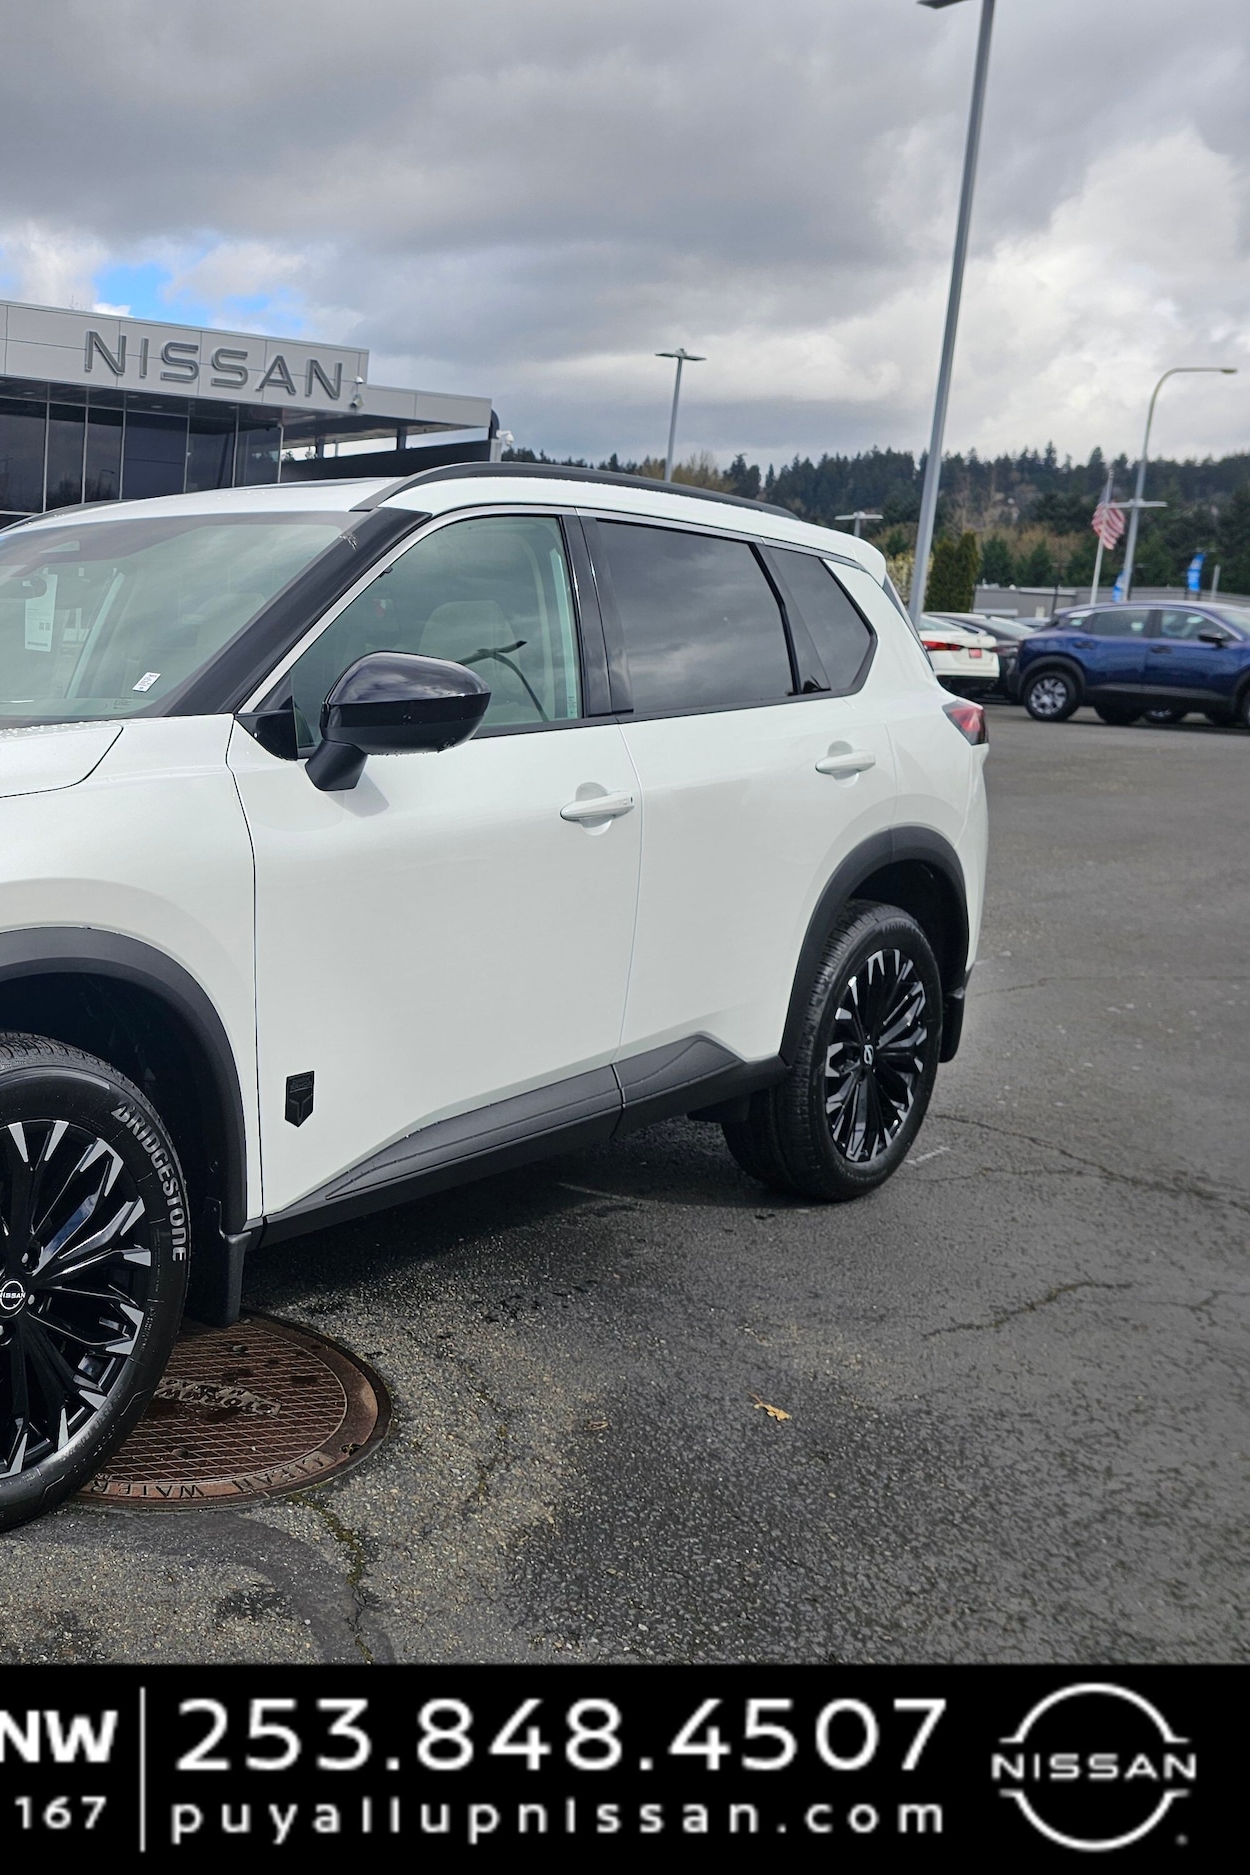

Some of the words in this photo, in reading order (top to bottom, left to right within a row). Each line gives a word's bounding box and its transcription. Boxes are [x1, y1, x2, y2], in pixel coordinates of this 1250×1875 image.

[85, 330, 342, 400] NISSAN
[111, 1100, 187, 1262] BRIDGESTONE
[91, 1479, 206, 1499] WATER
